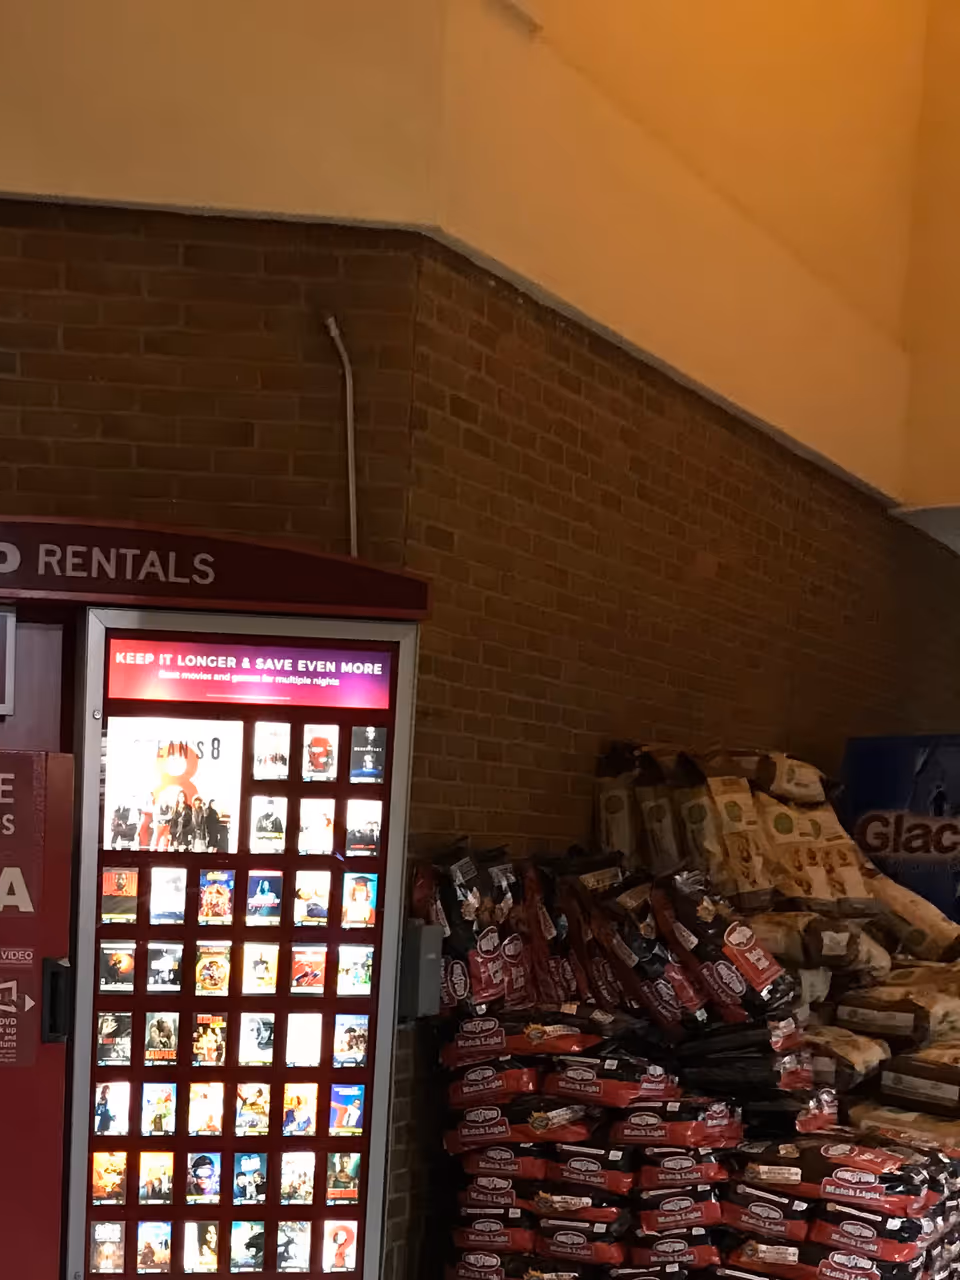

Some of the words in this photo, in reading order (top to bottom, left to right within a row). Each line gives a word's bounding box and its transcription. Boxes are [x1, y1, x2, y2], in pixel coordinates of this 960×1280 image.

[38, 543, 216, 585] RENTALS
[115, 652, 154, 665] KEEP
[159, 654, 172, 666] IT
[178, 654, 236, 668] LONGER
[242, 656, 250, 669] &
[255, 658, 292, 671] SAVE
[298, 660, 336, 673] EVEN
[341, 662, 382, 675] MORE
[182, 671, 211, 680] movies
[214, 672, 230, 681] and
[276, 674, 311, 686] multiple
[313, 677, 340, 686] nights
[211, 737, 221, 760] 8
[1, 951, 33, 960] VIDEO
[825, 1185, 855, 1196] Match
[856, 1188, 881, 1200] Light
